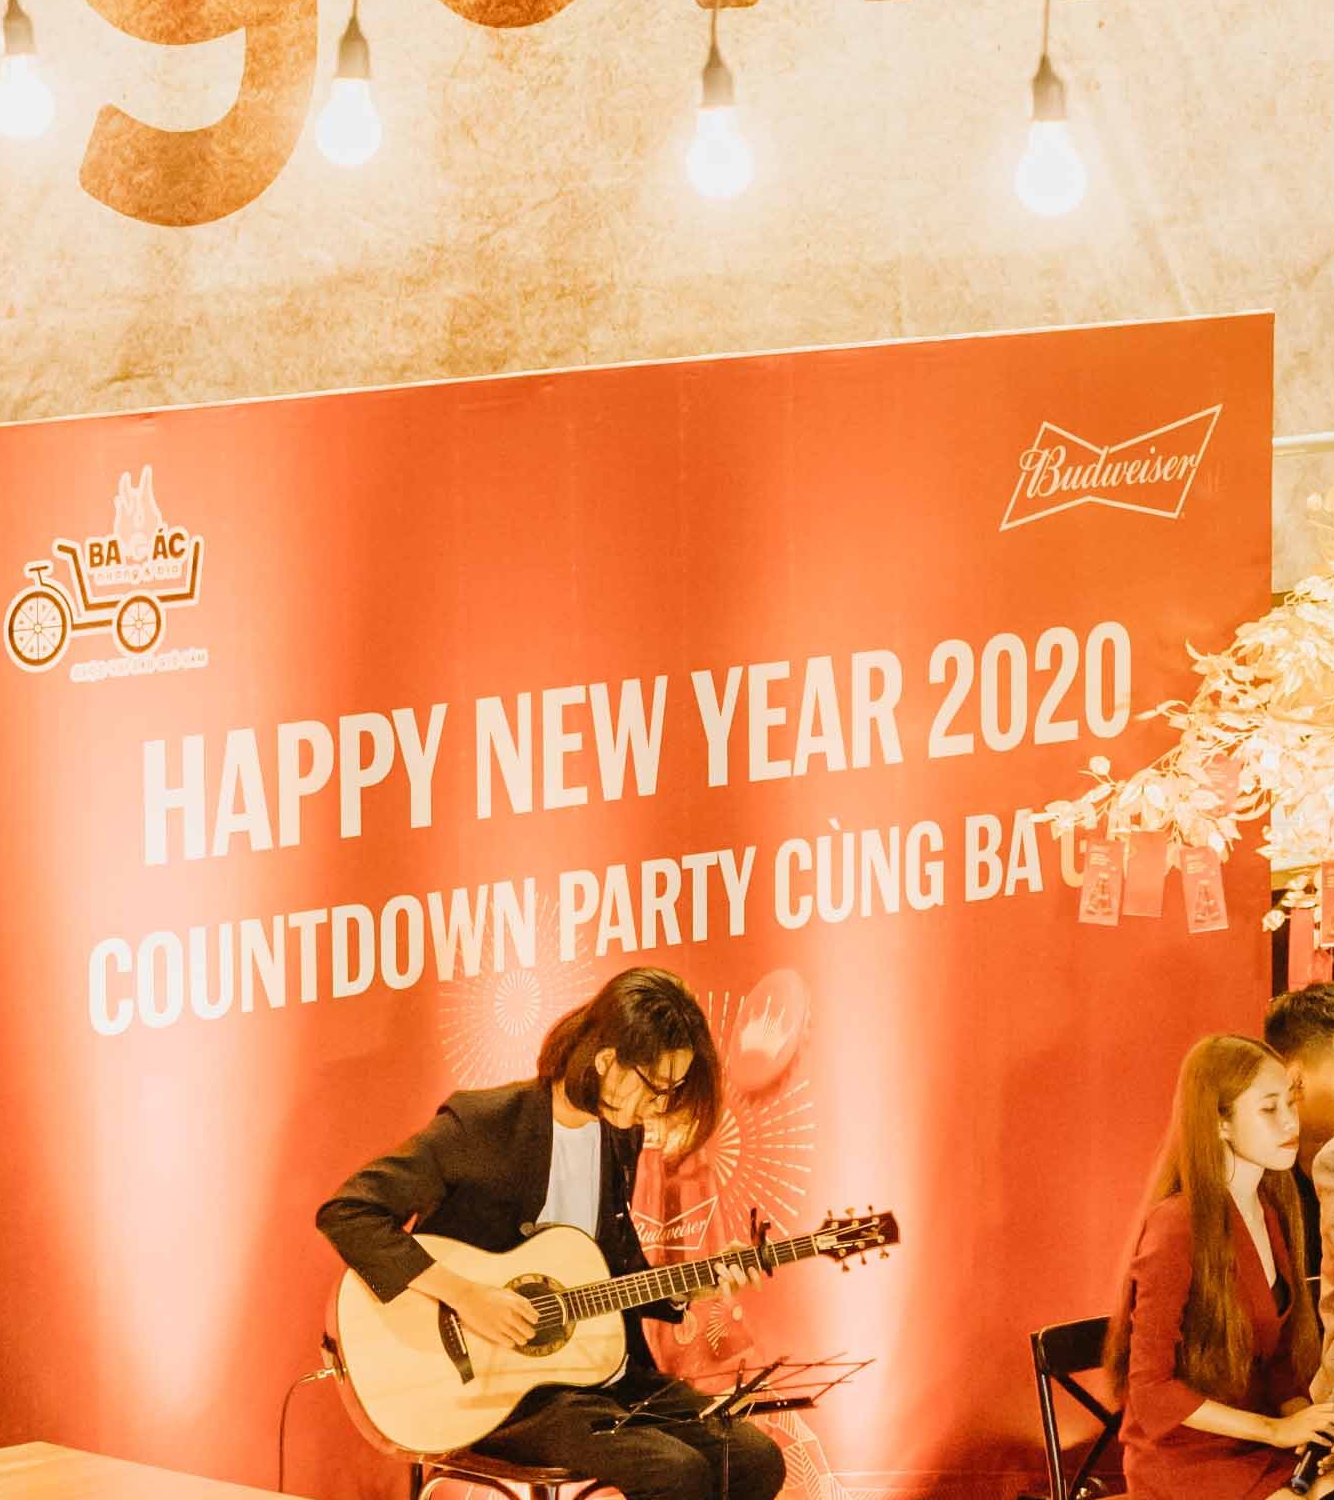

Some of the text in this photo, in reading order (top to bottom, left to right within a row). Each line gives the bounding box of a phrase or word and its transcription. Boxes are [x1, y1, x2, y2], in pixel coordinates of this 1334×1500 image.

[1019, 445, 1199, 498] Budweiser
[88, 539, 122, 568] BA
[142, 621, 1133, 867] HAPPY NEW YEAR 2020
[88, 878, 535, 1035] COUNTDOWN
[560, 845, 757, 962] PARTY
[774, 817, 944, 929] CÙNG
[965, 808, 1043, 902] BA
